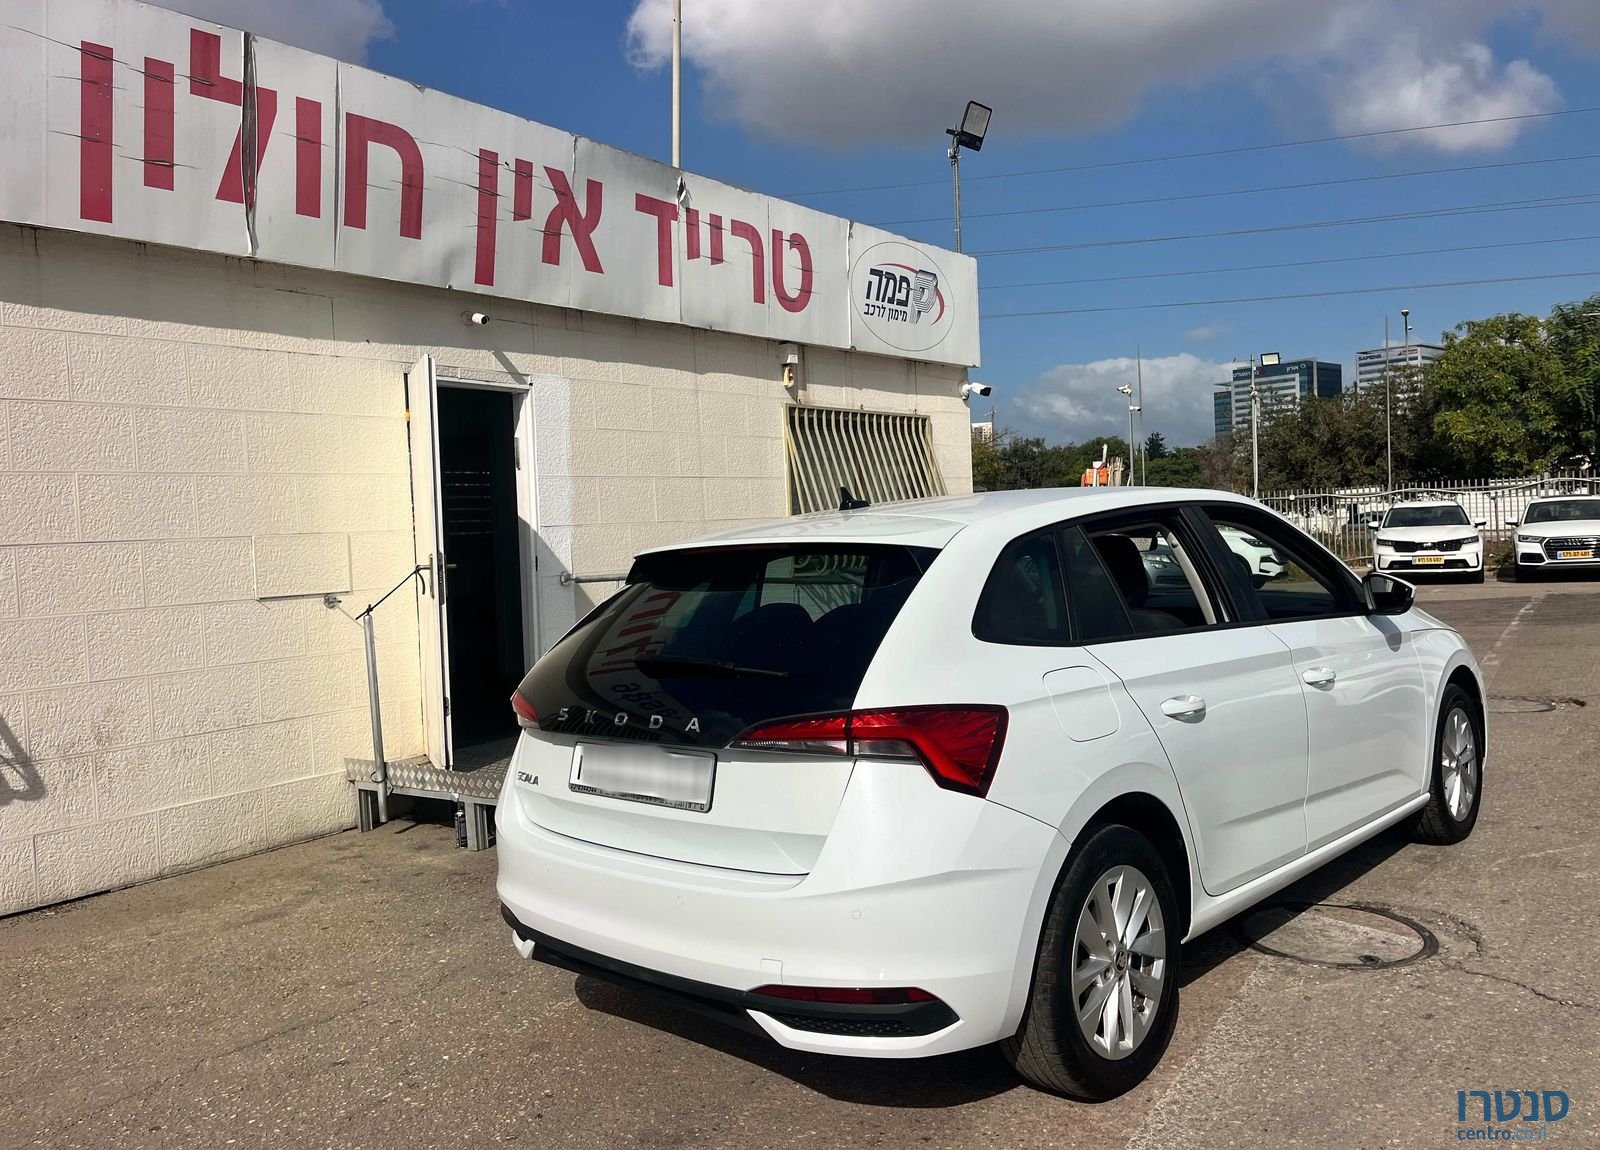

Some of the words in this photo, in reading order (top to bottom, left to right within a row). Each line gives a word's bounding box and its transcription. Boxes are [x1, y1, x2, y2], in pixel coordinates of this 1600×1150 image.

[80, 28, 424, 240] חולון
[474, 148, 604, 286] אין
[635, 193, 813, 313] טרייד
[864, 303, 887, 318] לרכב
[866, 268, 911, 307] פמה
[887, 307, 908, 322] מימון
